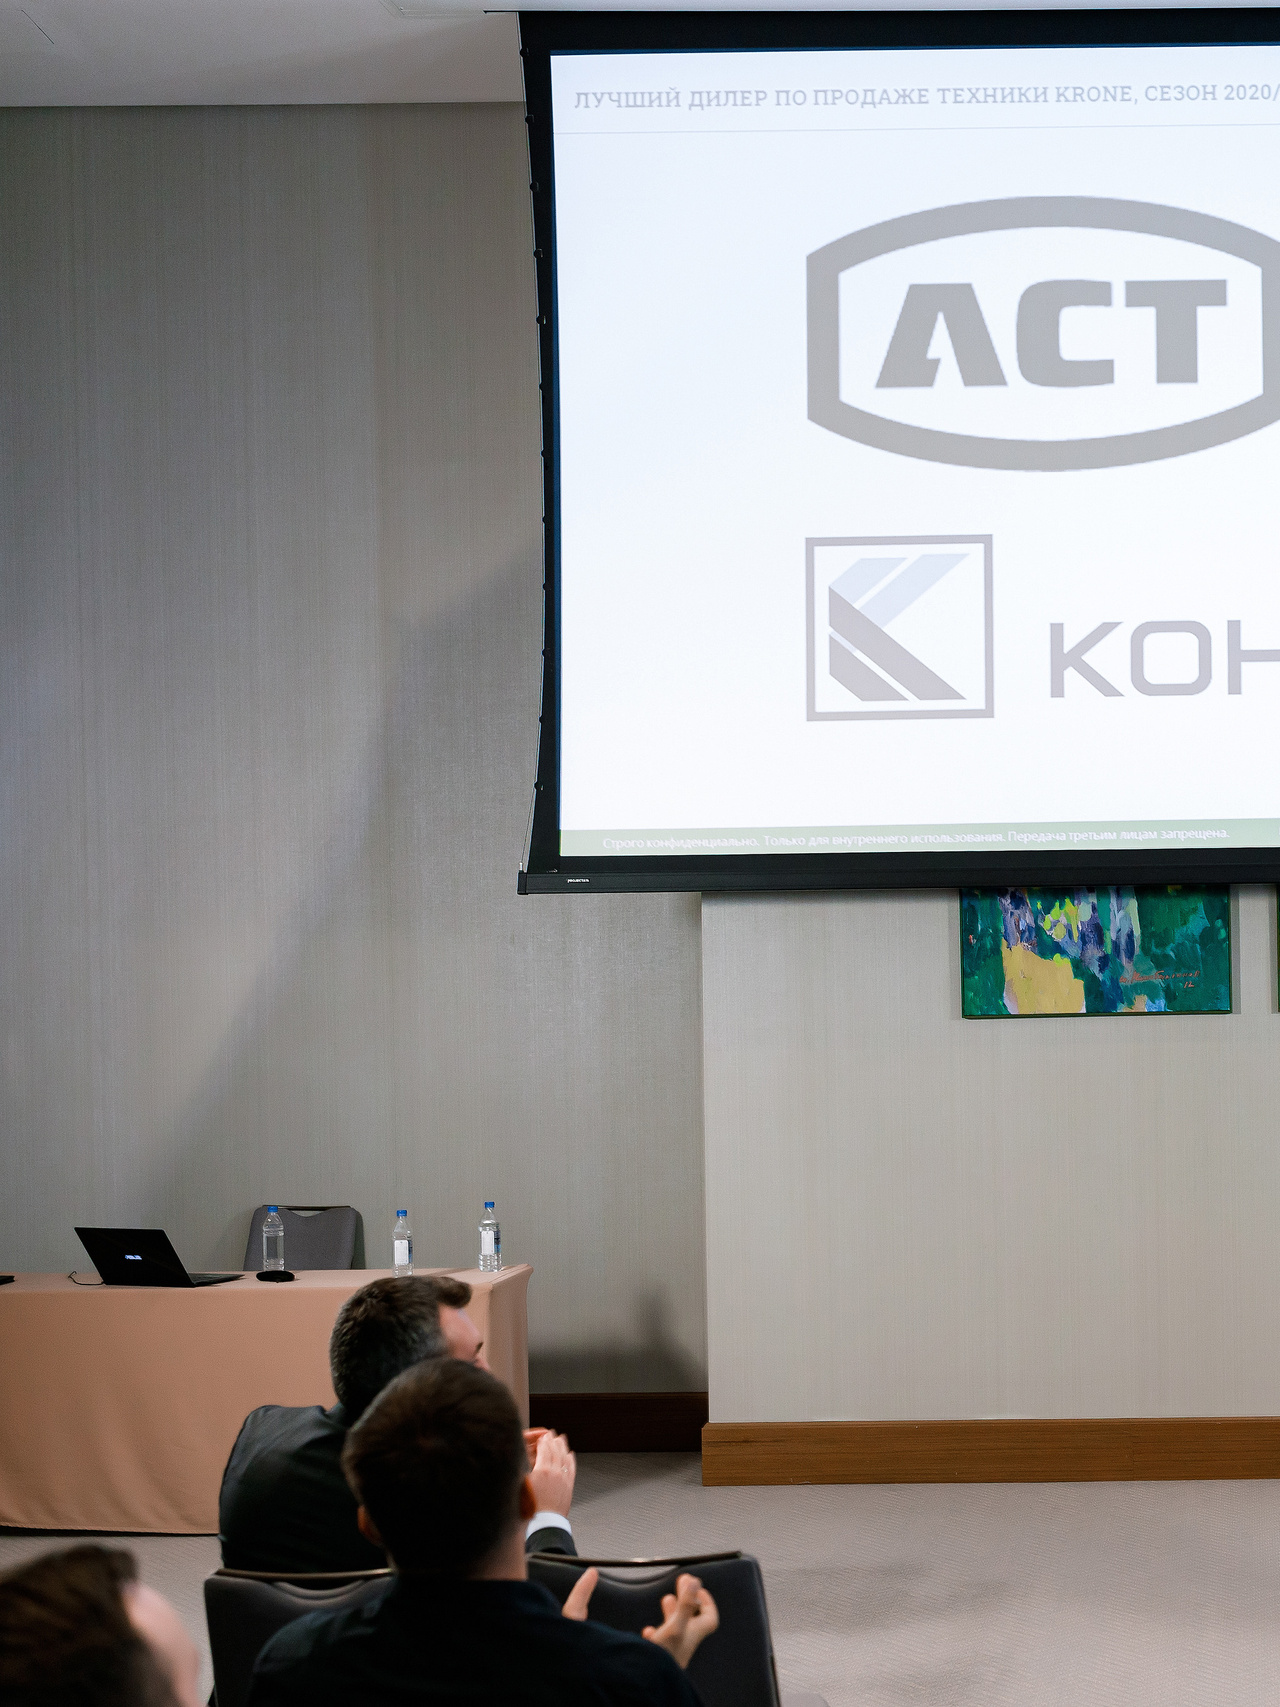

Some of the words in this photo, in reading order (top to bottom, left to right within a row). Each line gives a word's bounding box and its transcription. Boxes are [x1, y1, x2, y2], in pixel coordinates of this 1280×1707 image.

[575, 87, 681, 108] ЛУЧШИЙ
[688, 90, 767, 110] ДИЛЕР
[775, 90, 807, 106] ПО
[813, 88, 929, 108] ПРОДАЖЕ
[937, 87, 1048, 104] ТЕХНИКИ
[1055, 86, 1138, 105] KRONE,
[1145, 85, 1217, 101] СЕЗОН
[603, 839, 644, 850] Строго
[646, 838, 759, 850] конфиденциально.
[763, 836, 806, 847] Только
[808, 837, 829, 847] для
[832, 836, 908, 847] внутреннего
[911, 833, 1006, 844] использования.
[1008, 831, 1066, 844] Передача
[1069, 831, 1117, 844] третьим
[1119, 830, 1157, 842] лицам
[1160, 830, 1230, 841] запрещена.
